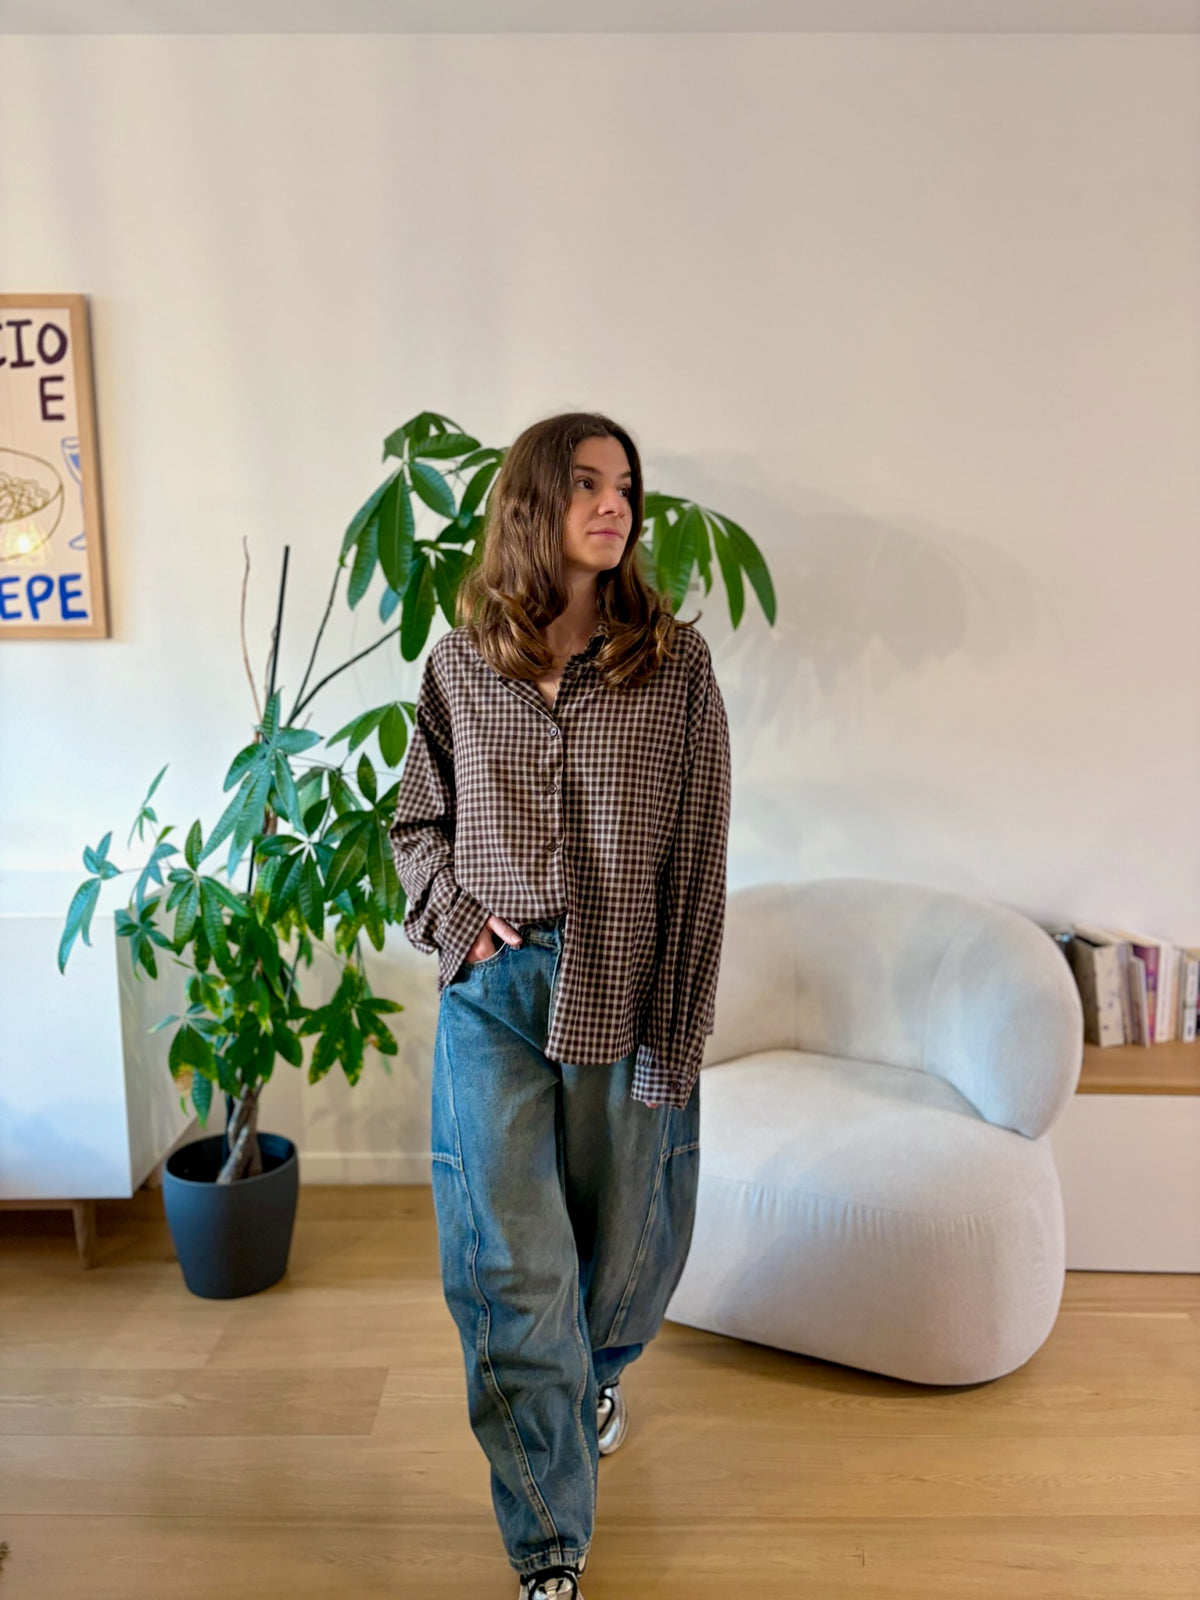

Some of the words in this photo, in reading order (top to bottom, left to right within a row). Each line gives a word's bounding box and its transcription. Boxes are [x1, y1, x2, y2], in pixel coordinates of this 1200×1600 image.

[0, 318, 68, 369] IO
[39, 375, 65, 421] E
[0, 573, 89, 621] EPE
